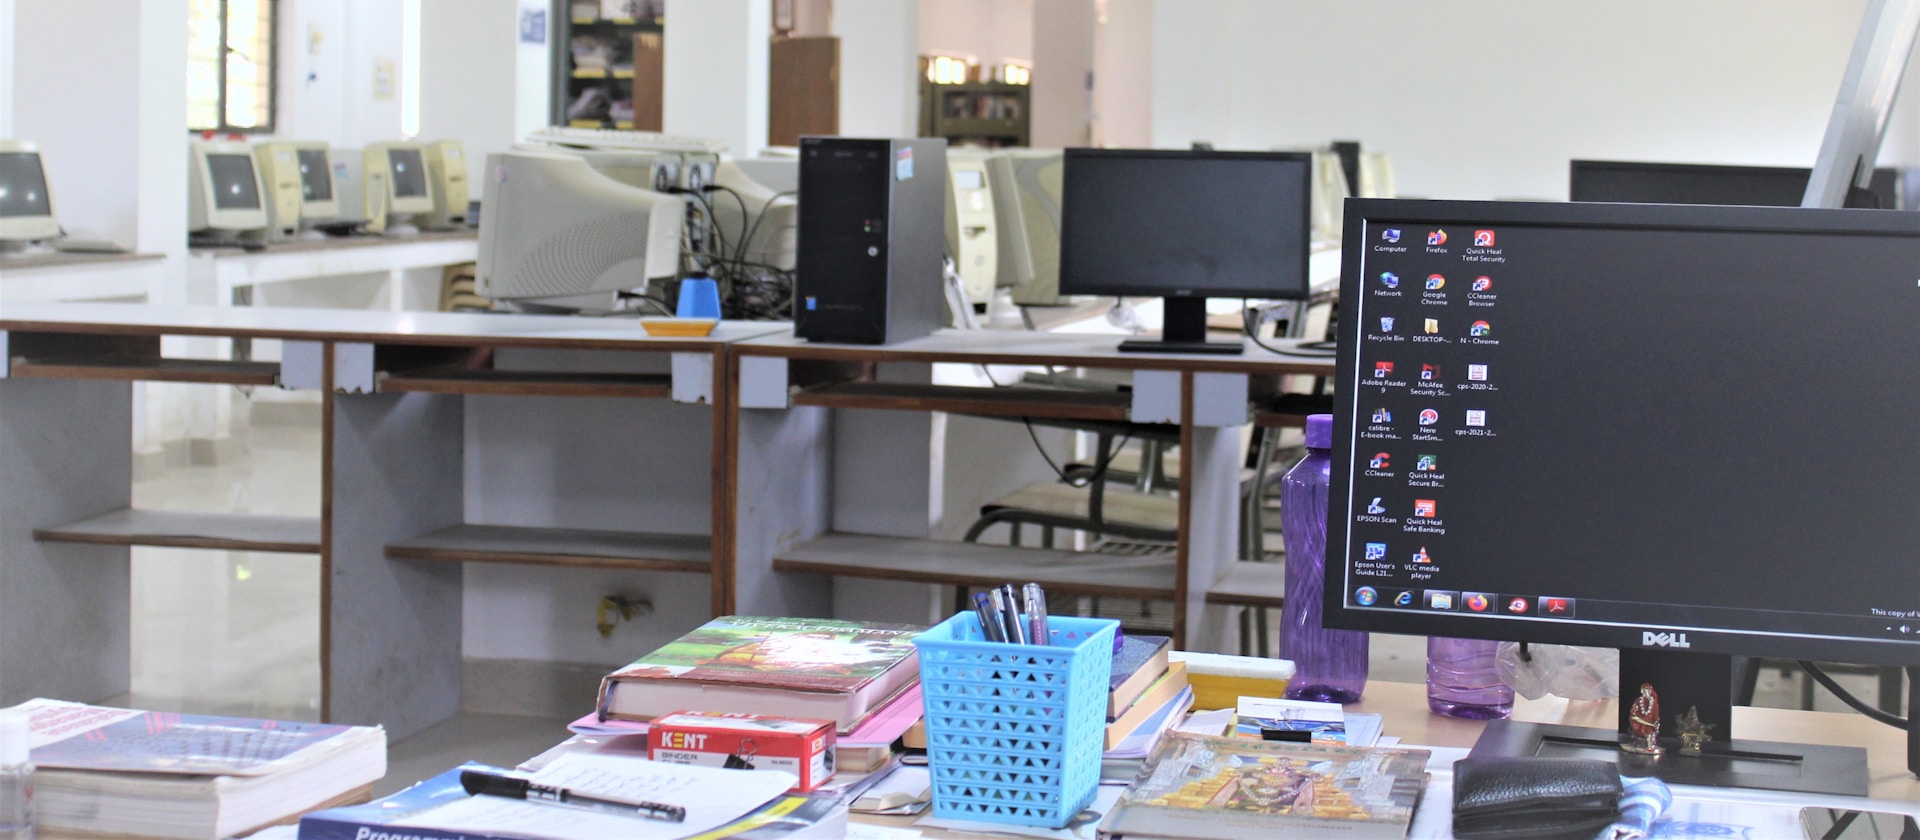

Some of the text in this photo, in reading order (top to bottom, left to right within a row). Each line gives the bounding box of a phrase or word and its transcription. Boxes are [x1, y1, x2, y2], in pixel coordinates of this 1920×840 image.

[1374, 245, 1408, 253] Computer
[1425, 246, 1448, 254] Firefox
[1465, 247, 1486, 255] Quick
[1461, 254, 1506, 264] Total Security
[1374, 289, 1402, 297] Network
[1422, 291, 1447, 300] Google
[1466, 292, 1497, 300] CCleaner
[1420, 298, 1448, 306] Chrome
[1468, 299, 1495, 307] Browser
[1472, 337, 1500, 345] Chrome
[1361, 378, 1407, 387] Adobe Reader
[1417, 381, 1444, 389] McAfee
[1410, 388, 1437, 397] Security
[1368, 424, 1391, 432] calibre
[1419, 426, 1437, 434] Nero
[1360, 431, 1384, 439] E-book
[1364, 469, 1395, 477] CCleaner
[1408, 471, 1445, 480] Quick Heal
[1408, 479, 1431, 487] Secure
[1356, 514, 1397, 524] EPSON Scan
[1406, 517, 1443, 526] Quick Heal
[1402, 525, 1446, 536] Safe Banking
[1354, 560, 1396, 570] Epson User's
[1403, 563, 1440, 573] VLC media
[1355, 568, 1376, 576] Guide
[1410, 572, 1432, 581] player
[1871, 607, 1887, 616] This
[1887, 609, 1906, 619] copy
[1642, 631, 1691, 648] DELL
[661, 731, 708, 750] KENT
[661, 751, 699, 761] BINDER
